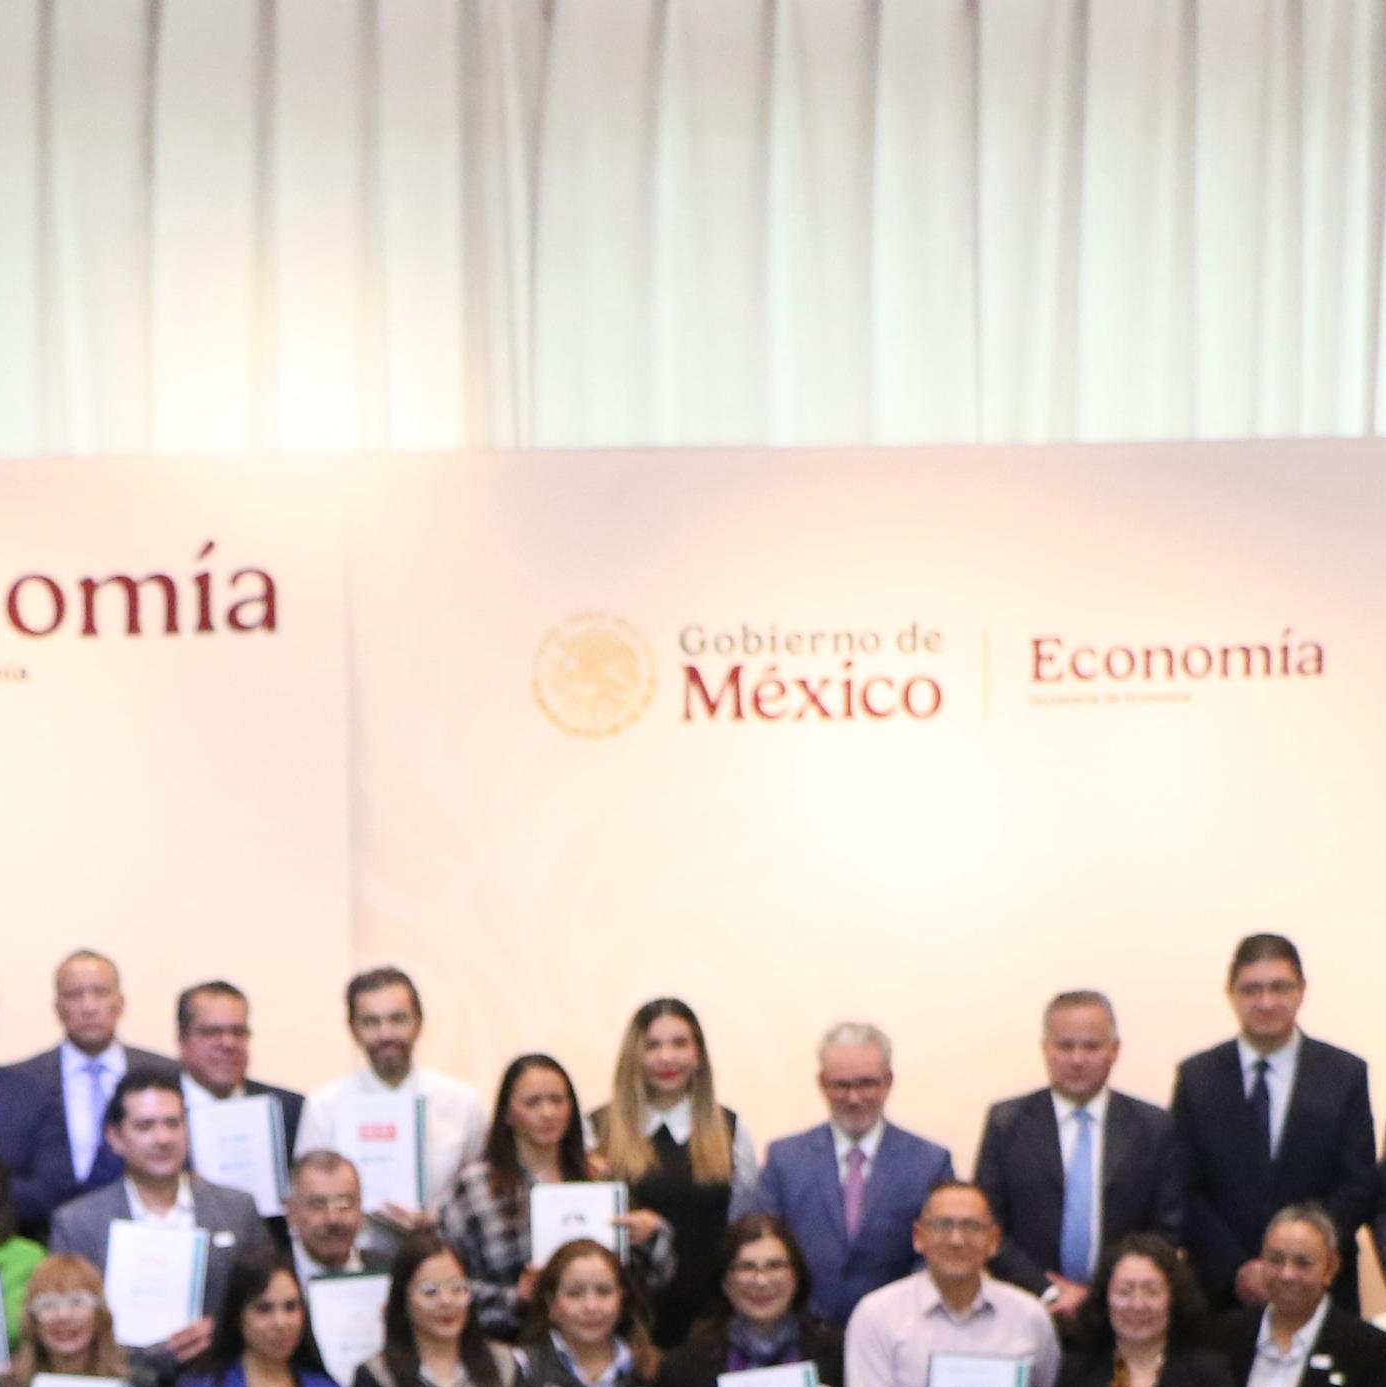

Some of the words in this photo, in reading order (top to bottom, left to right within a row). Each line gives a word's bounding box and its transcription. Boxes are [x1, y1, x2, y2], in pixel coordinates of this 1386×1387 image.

[679, 622, 882, 657] Gobierno
[897, 622, 942, 654] de
[1030, 627, 1325, 684] Economía
[683, 659, 943, 721] México
